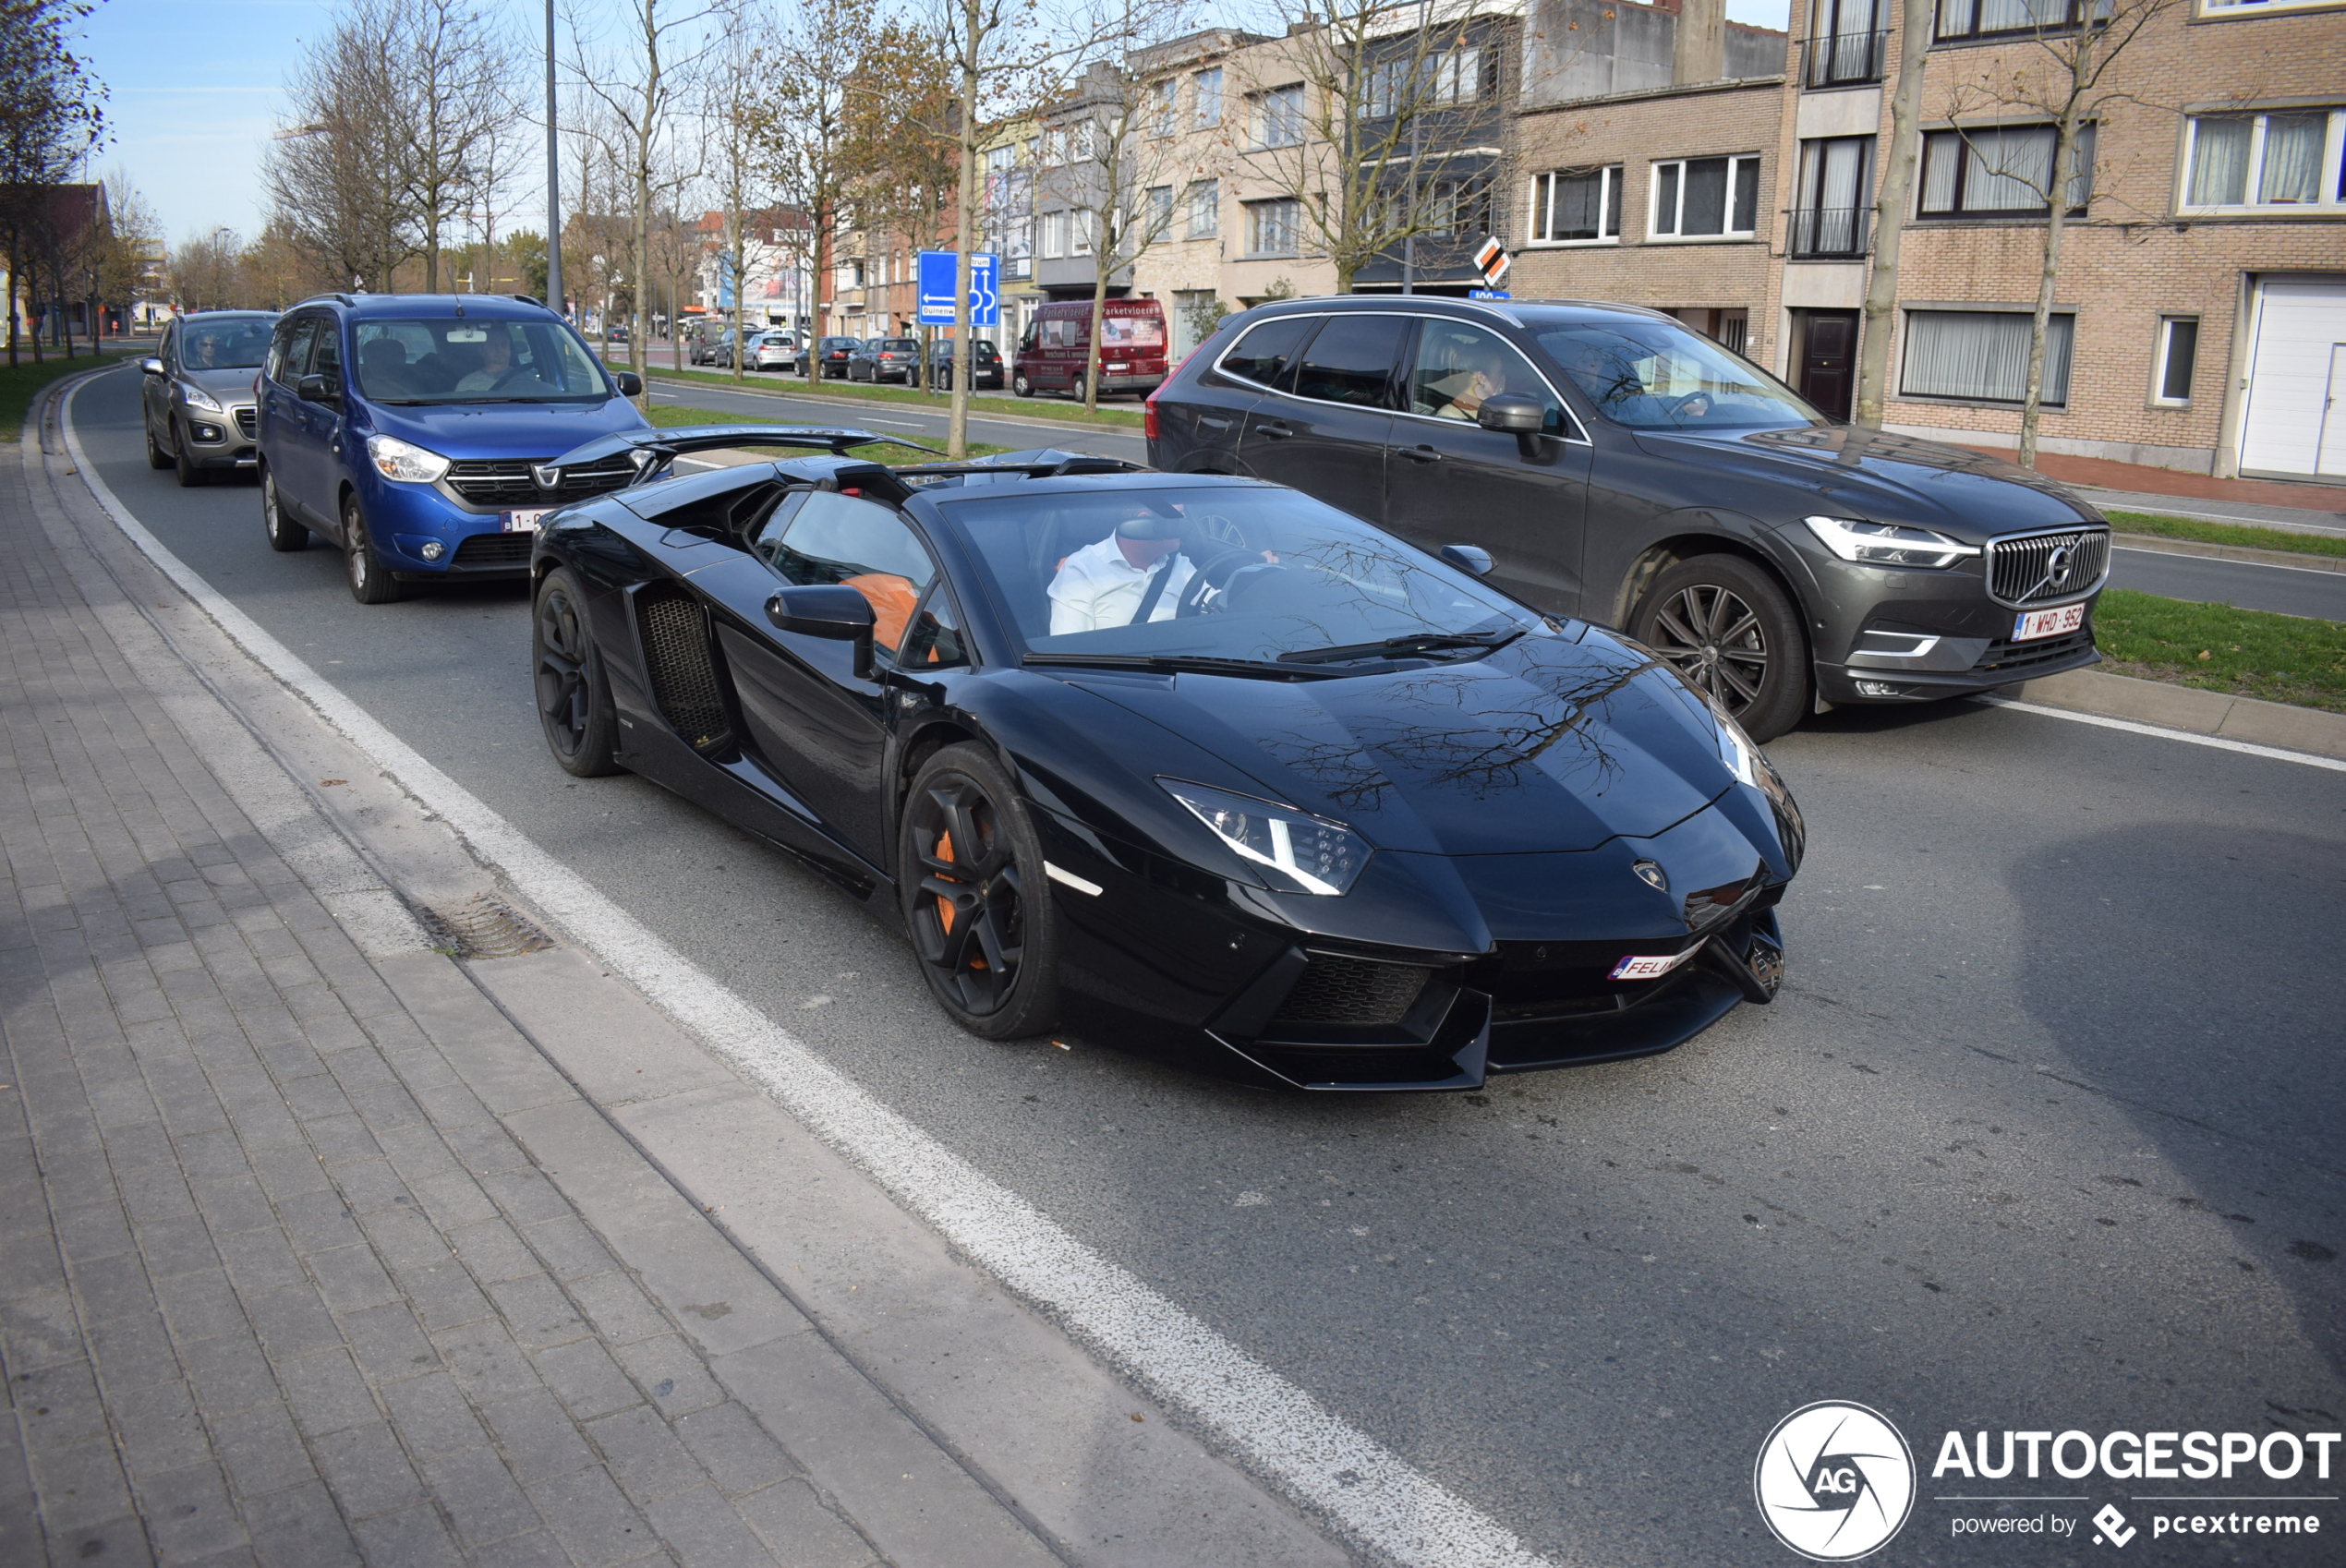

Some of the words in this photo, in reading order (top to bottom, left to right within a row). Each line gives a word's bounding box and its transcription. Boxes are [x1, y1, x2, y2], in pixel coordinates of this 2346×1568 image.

[924, 307, 954, 315] Duinenw
[1102, 306, 1160, 316] Parketvloeren
[504, 522, 511, 530] B
